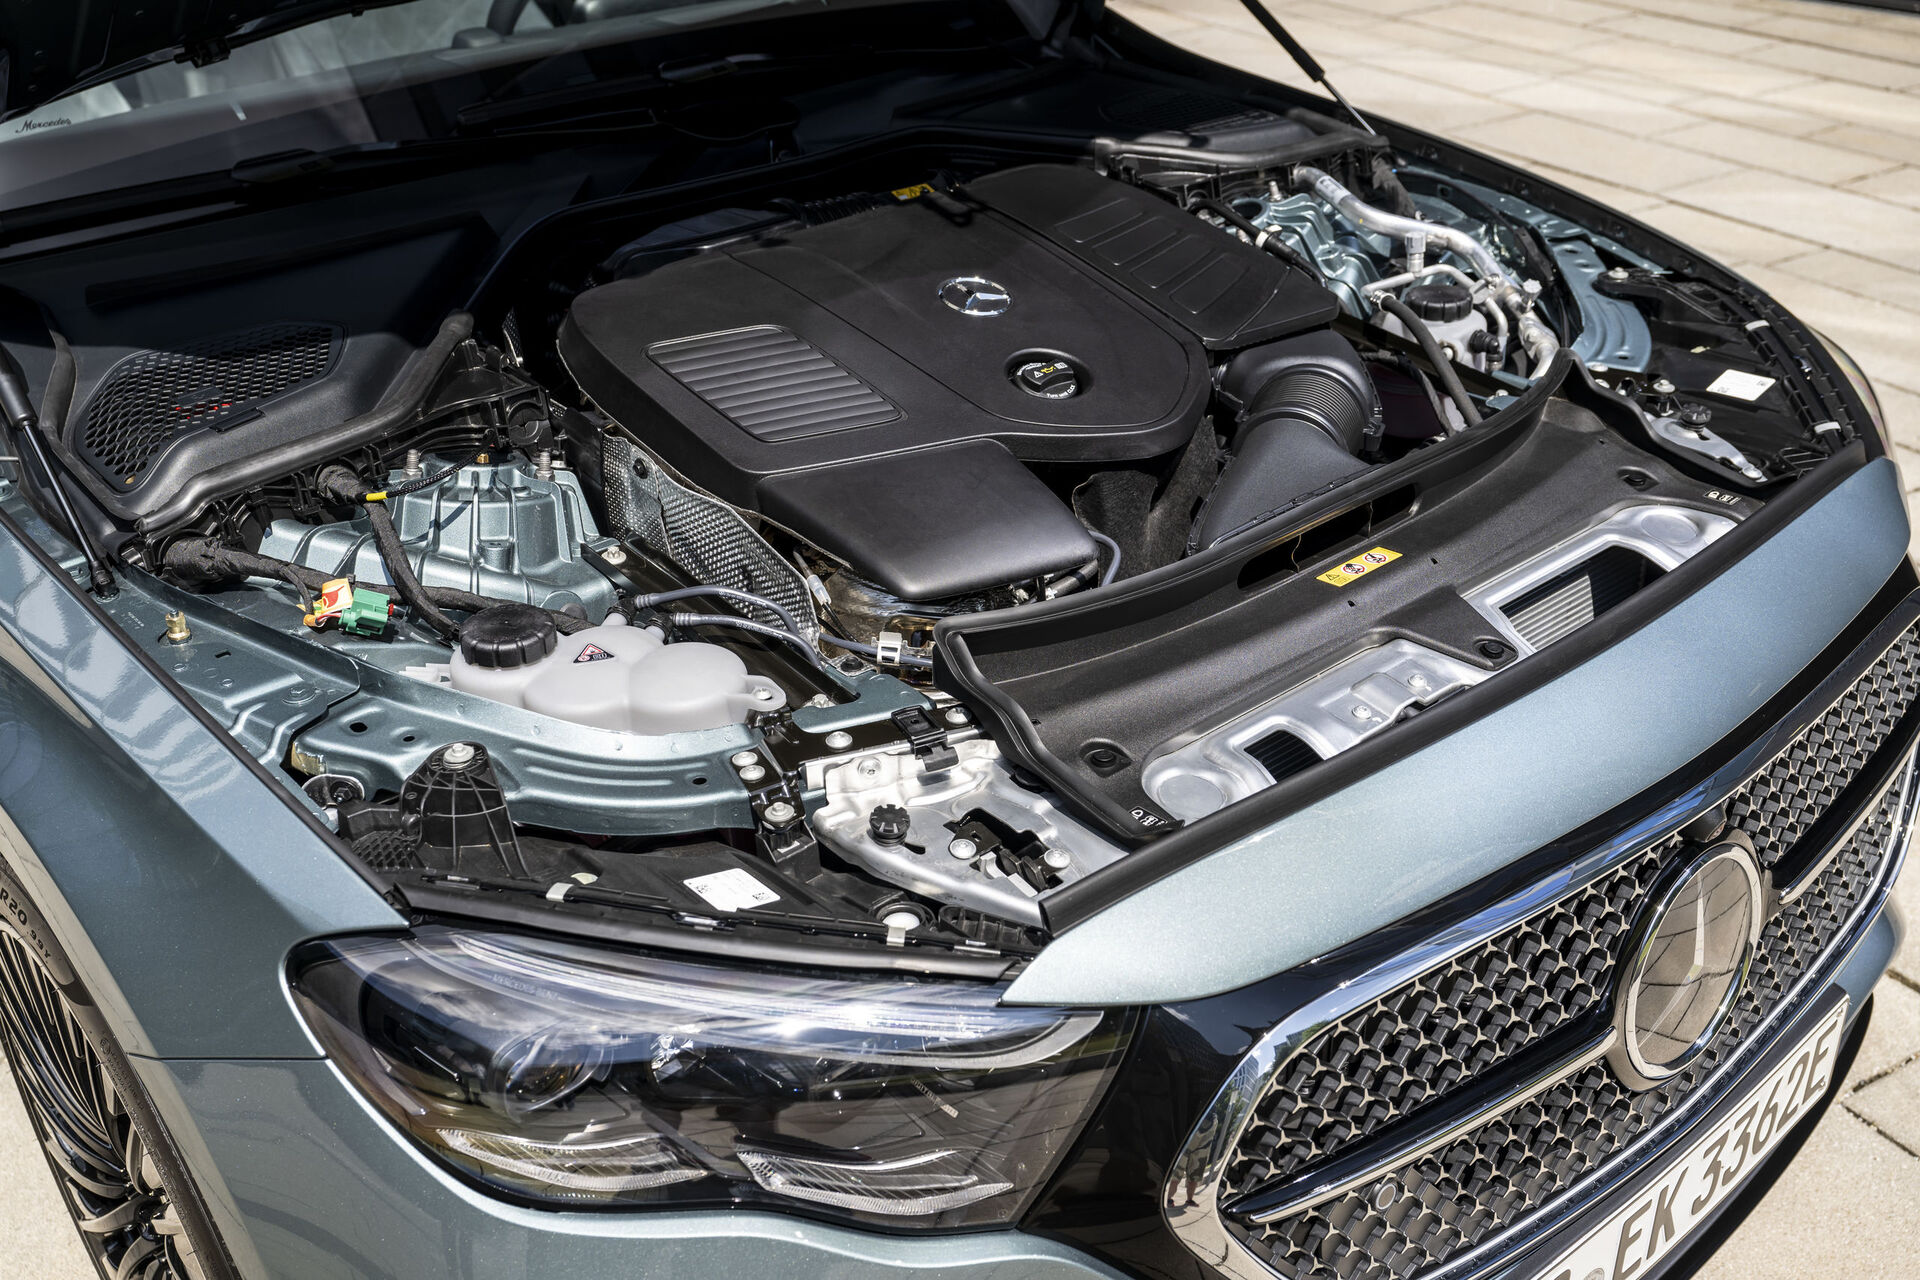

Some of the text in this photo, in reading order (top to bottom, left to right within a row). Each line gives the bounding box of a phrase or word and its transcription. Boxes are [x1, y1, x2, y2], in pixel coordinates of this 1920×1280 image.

[15, 117, 72, 134] Mercedes
[1612, 1019, 1840, 1280] EK 3362E
